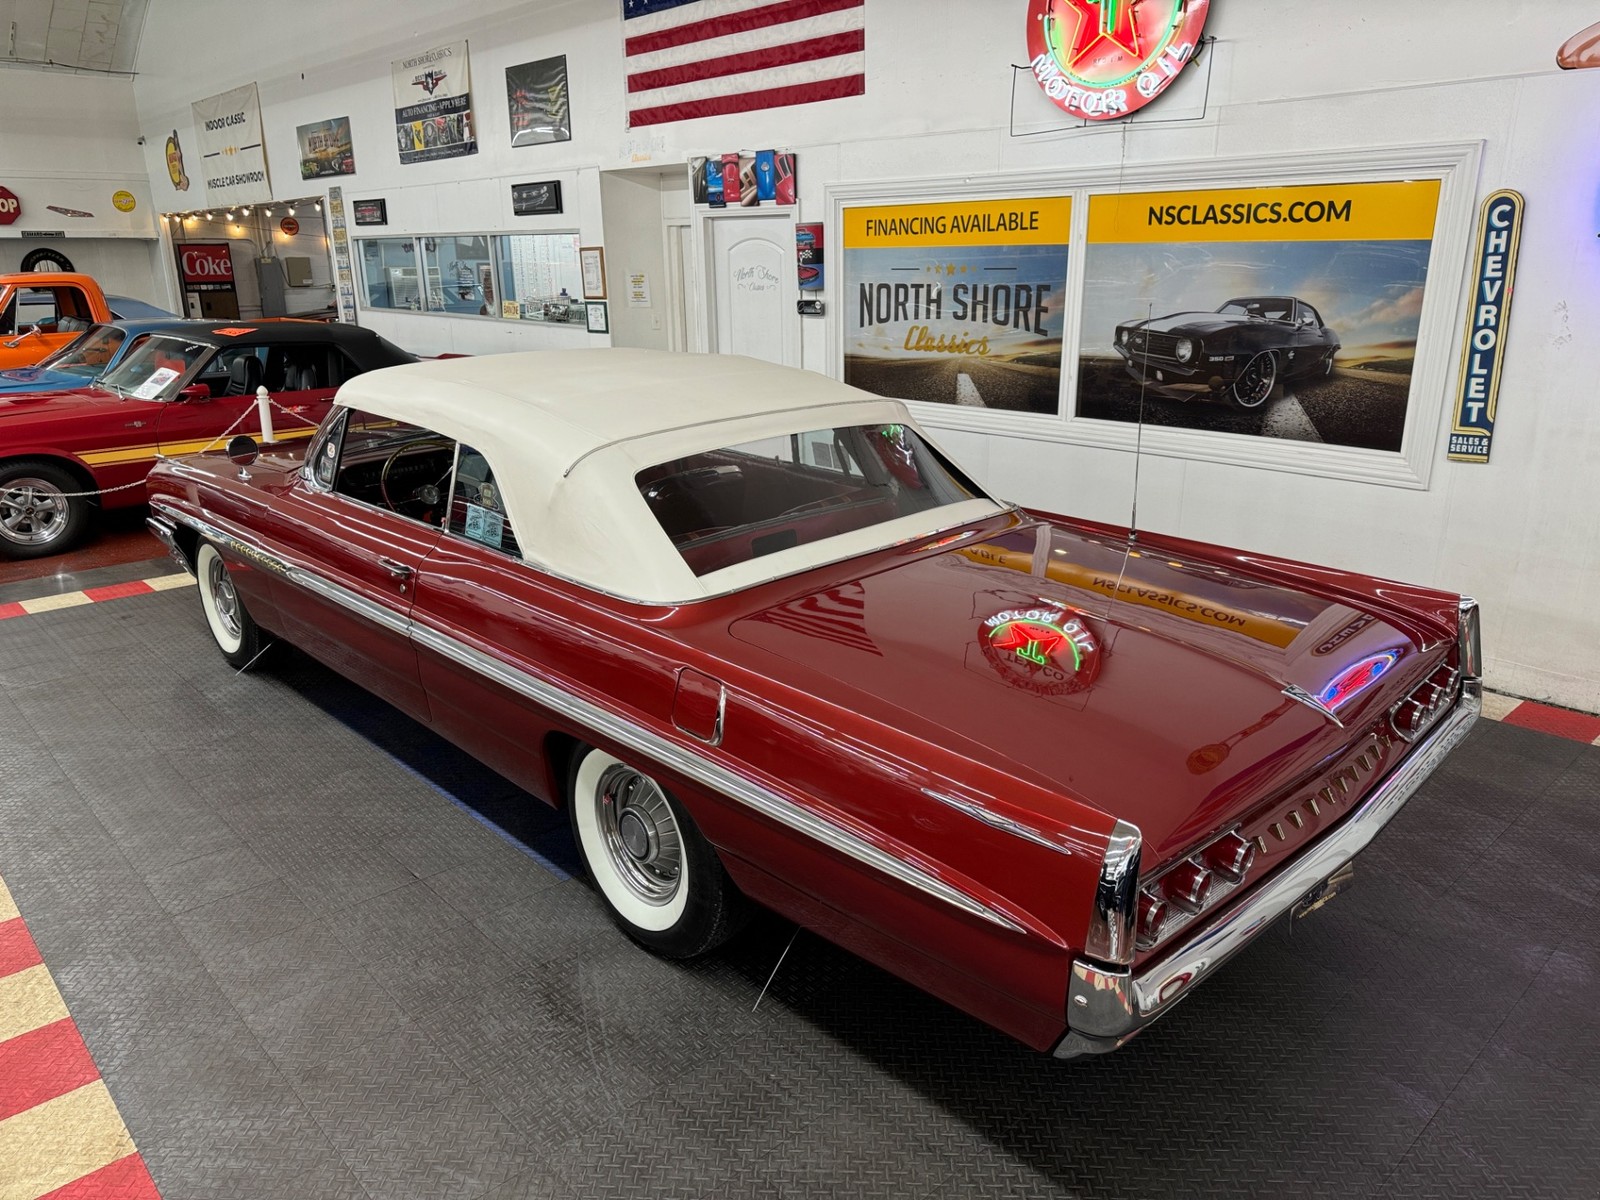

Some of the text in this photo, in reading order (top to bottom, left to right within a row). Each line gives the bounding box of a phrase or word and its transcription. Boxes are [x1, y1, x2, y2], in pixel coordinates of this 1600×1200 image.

[1031, 42, 1193, 116] MOTOR OIL
[225, 176, 236, 187] CAR
[0, 198, 18, 213] OP
[1148, 199, 1352, 226] NSCLASSICS.COM
[866, 211, 1040, 237] FINANCING AVAILABLE
[182, 251, 233, 276] Coke
[859, 282, 1052, 337] NORTH SHORE
[1466, 204, 1512, 424] CHEVROLET
[903, 325, 991, 356] Classics
[1450, 444, 1488, 455] SERVICE
[1451, 435, 1489, 446] SALES &
